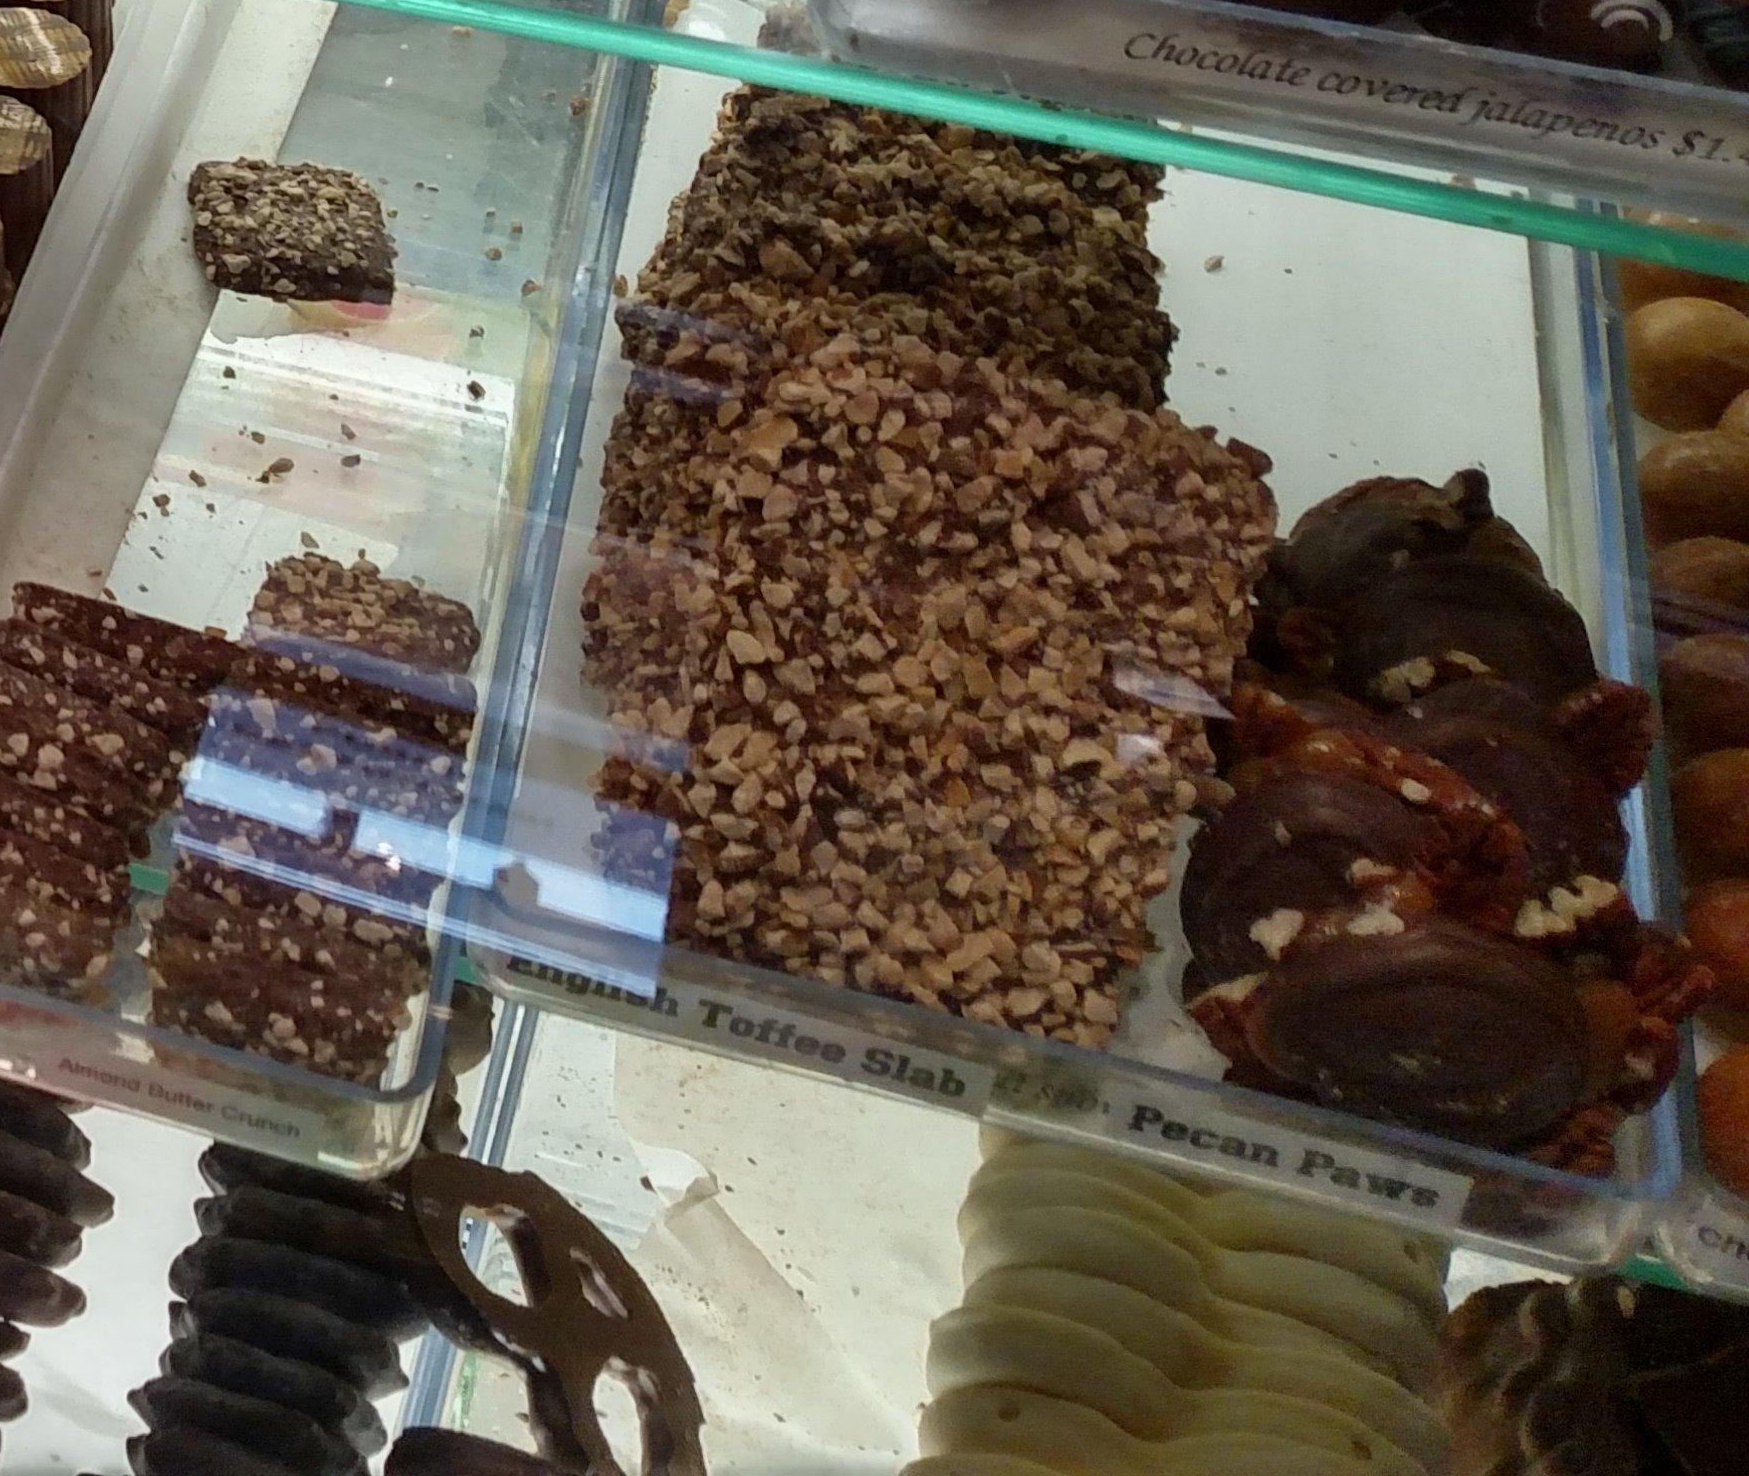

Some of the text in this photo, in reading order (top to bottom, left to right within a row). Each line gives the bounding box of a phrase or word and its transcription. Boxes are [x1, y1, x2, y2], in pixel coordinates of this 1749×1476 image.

[1123, 31, 1312, 88] Chocolate
[1316, 66, 1465, 115] covered
[1459, 87, 1663, 152] jalapenos
[58, 1056, 301, 1140] Almond Butter Crunch
[697, 998, 847, 1065] Toffee
[860, 1046, 967, 1100] Slab
[1130, 1105, 1441, 1209] Pecan Paws
